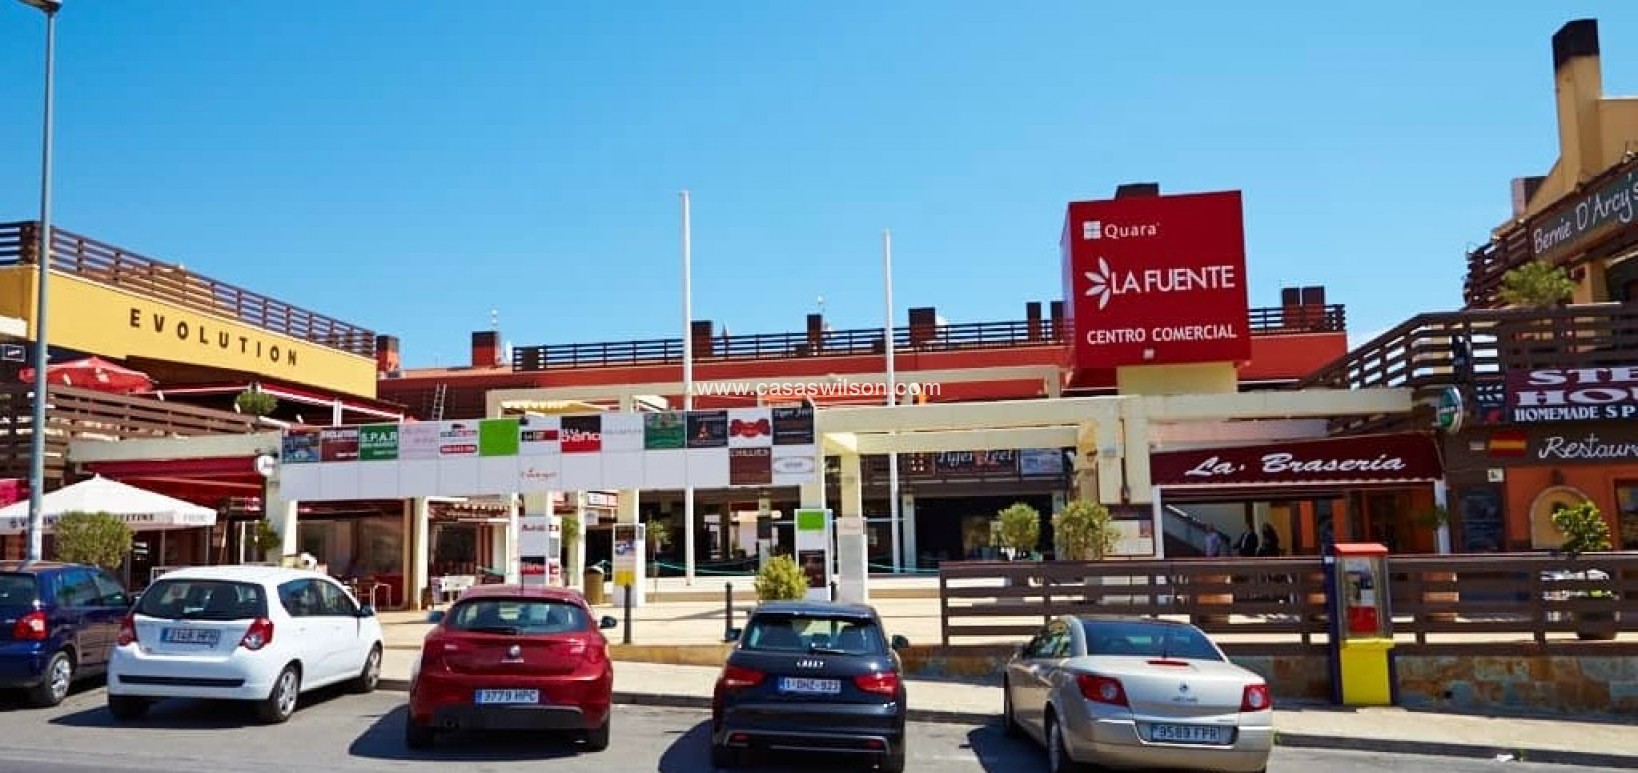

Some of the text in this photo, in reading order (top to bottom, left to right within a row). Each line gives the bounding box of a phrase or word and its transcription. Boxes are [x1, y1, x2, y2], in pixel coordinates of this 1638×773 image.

[1533, 217, 1573, 254] Bernie
[1111, 265, 1236, 295] LA FUENTE
[129, 308, 298, 366] EVOLUTION
[1086, 323, 1238, 345] CENTRO COMERCIAL
[1515, 387, 1638, 406] HO
[1514, 405, 1600, 422] HOMEMADE
